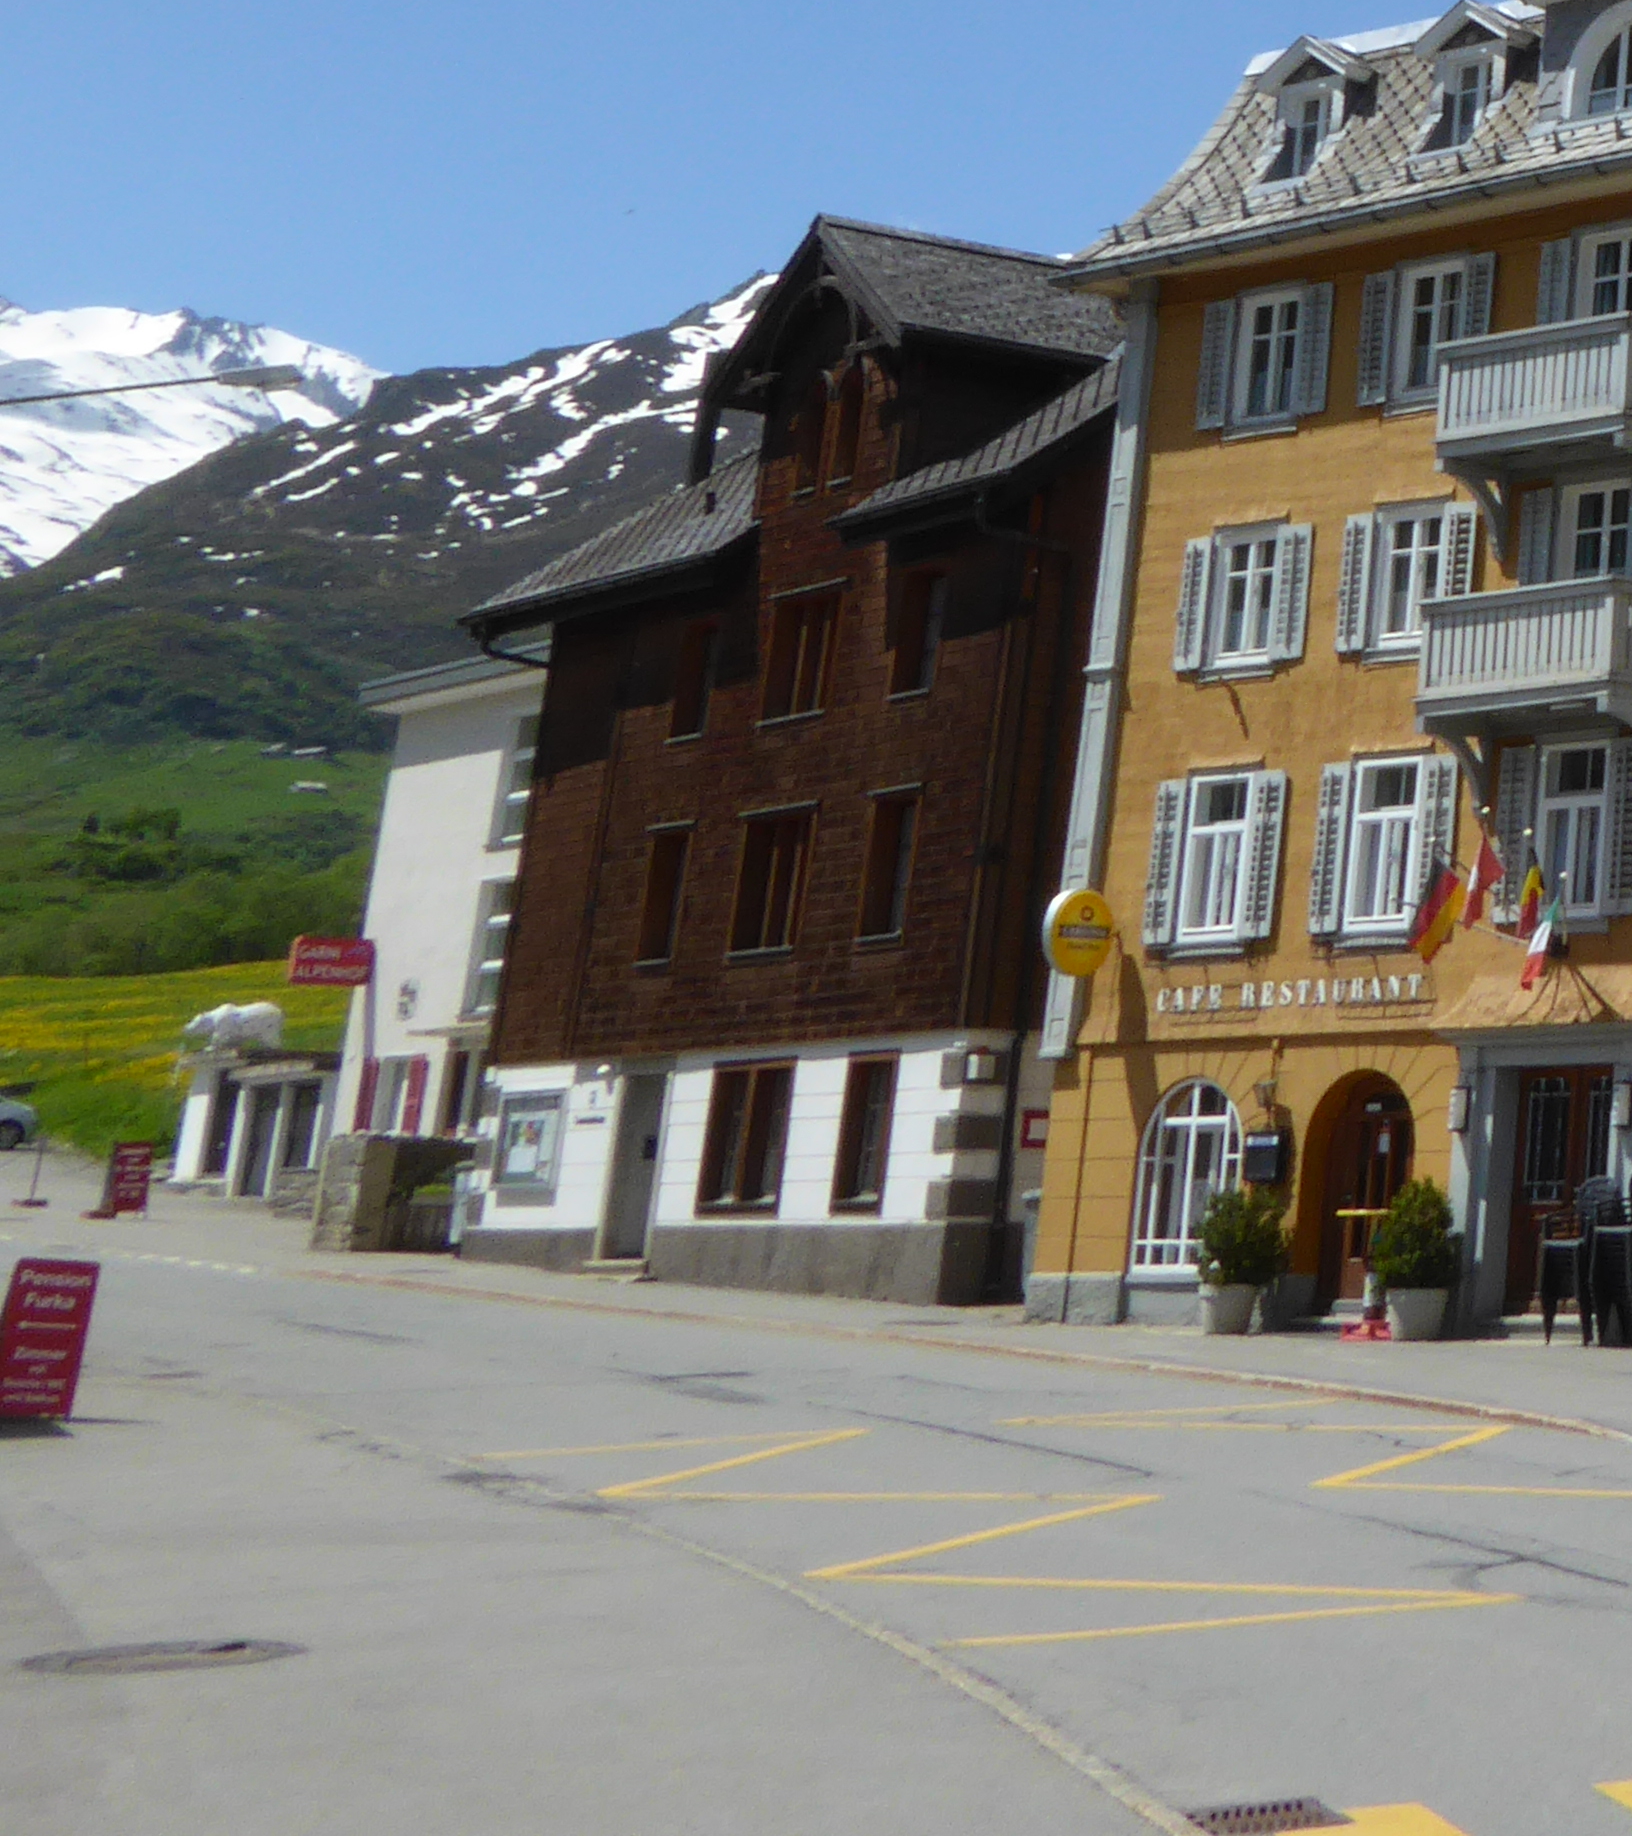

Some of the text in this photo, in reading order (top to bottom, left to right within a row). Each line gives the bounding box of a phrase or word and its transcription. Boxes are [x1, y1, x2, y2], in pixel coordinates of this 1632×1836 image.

[1156, 973, 1422, 1012] CAFE RESTAURANT
[19, 1269, 92, 1288] Pension
[23, 1291, 77, 1310] Furka
